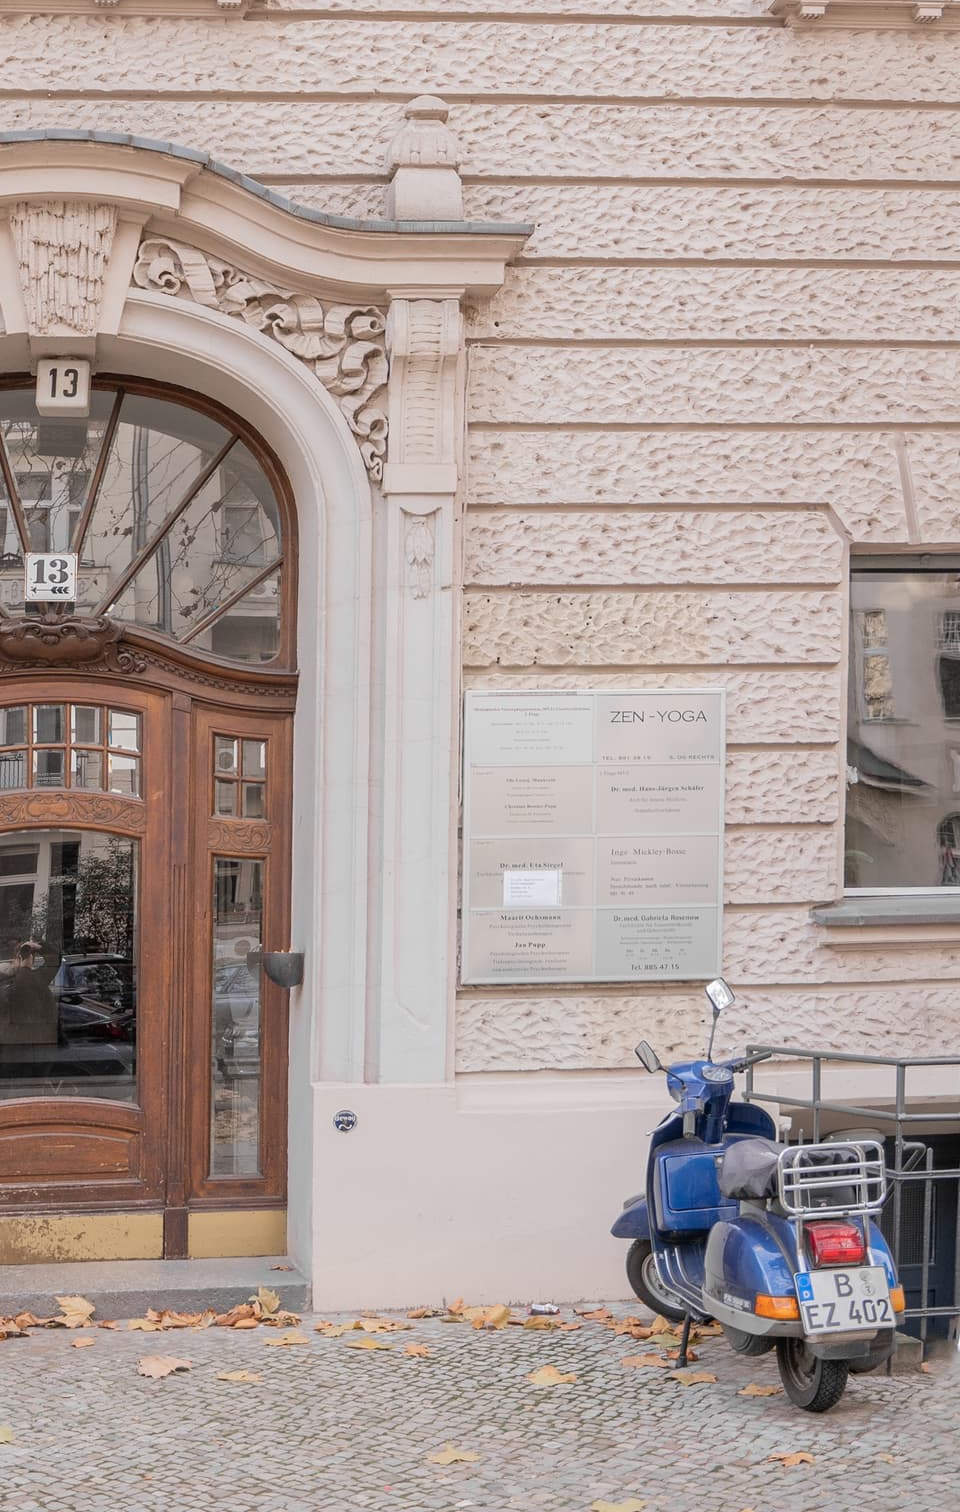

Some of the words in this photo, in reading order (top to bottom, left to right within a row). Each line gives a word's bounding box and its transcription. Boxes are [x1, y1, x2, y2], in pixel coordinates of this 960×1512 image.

[49, 368, 79, 398] 13
[33, 559, 70, 584] 13
[833, 1273, 853, 1297] B
[806, 1302, 841, 1329] EZ
[849, 1299, 892, 1324] 402
